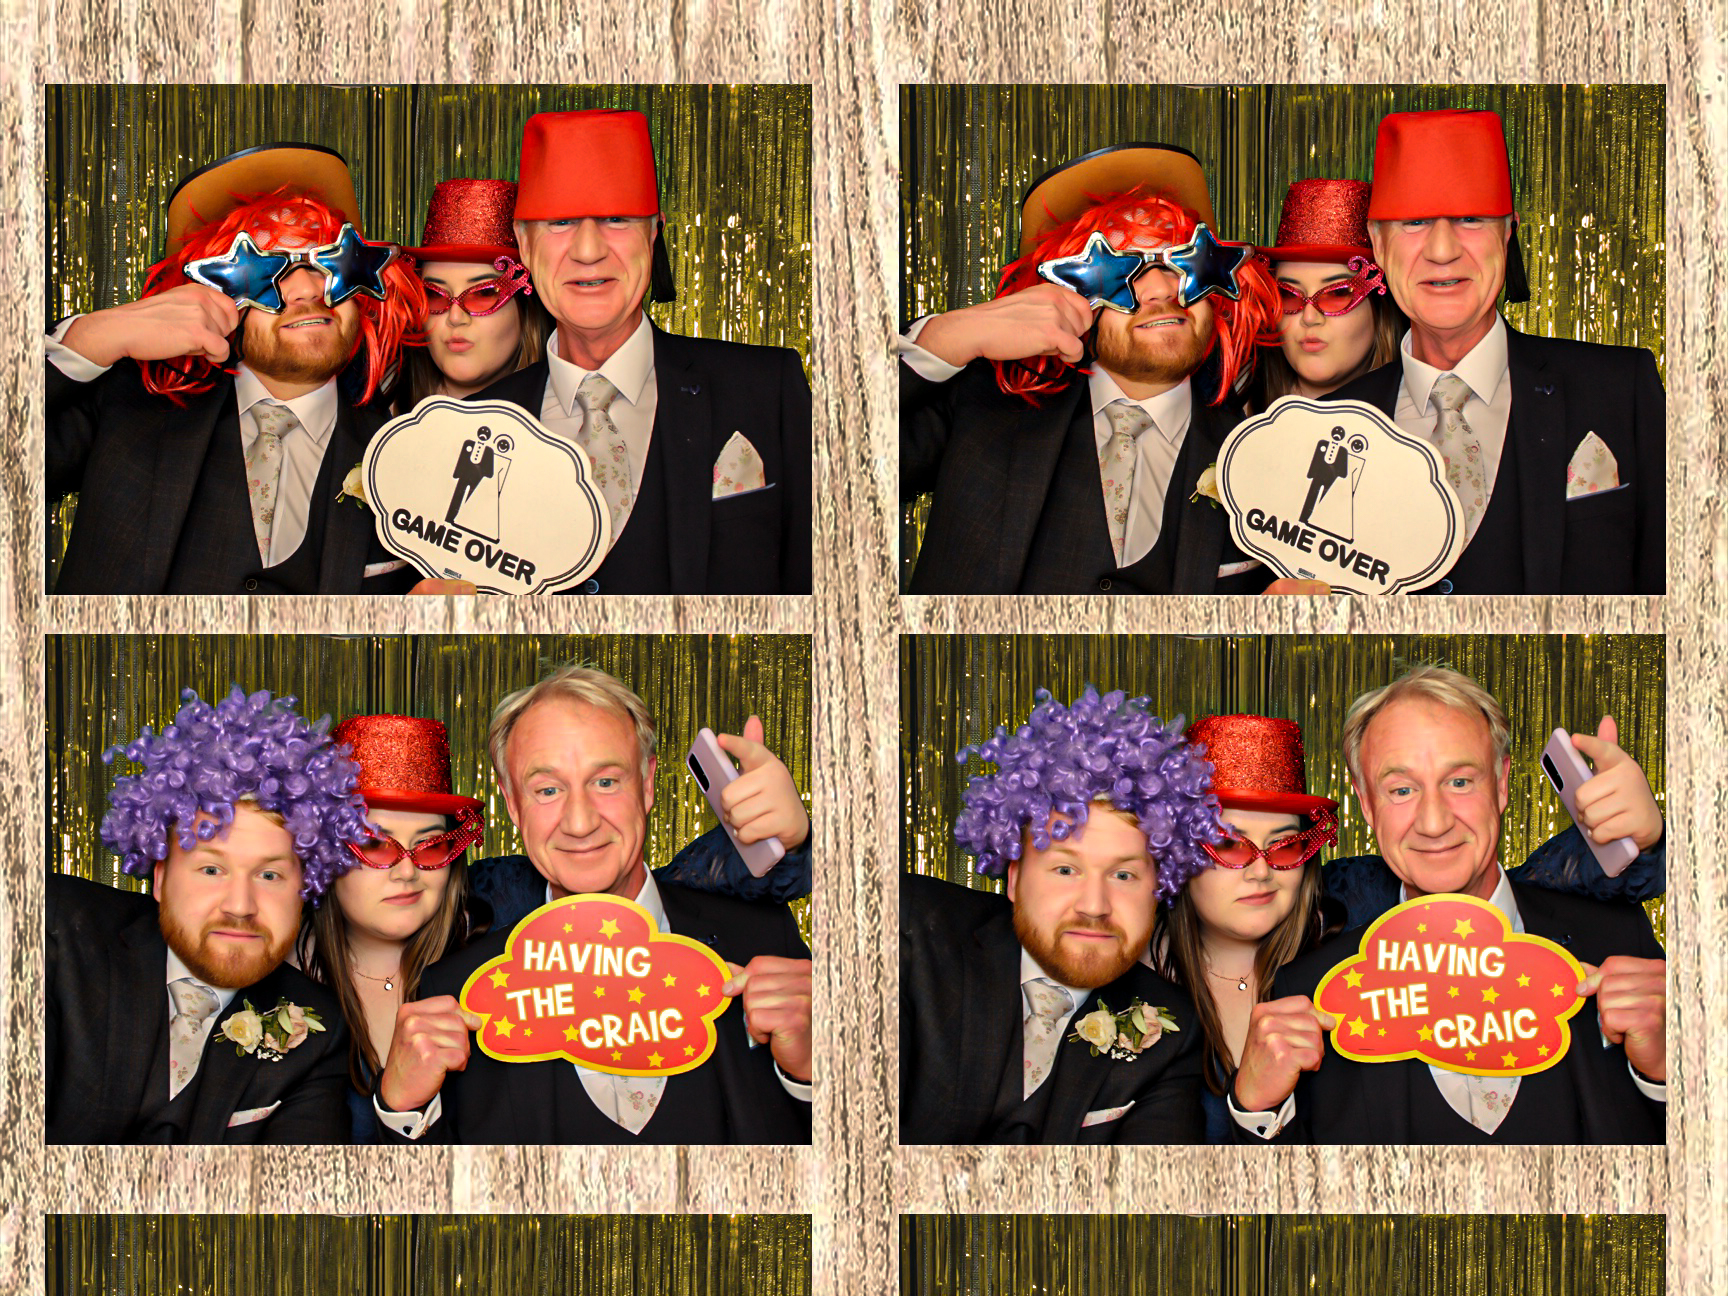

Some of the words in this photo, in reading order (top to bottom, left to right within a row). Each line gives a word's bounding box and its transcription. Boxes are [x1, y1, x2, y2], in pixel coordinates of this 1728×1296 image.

[392, 508, 463, 553] GAME
[464, 539, 536, 585] OVER
[1246, 508, 1317, 553] GAME
[1318, 539, 1390, 585] OVER
[522, 939, 652, 977] HAVING
[1376, 939, 1506, 977] HAVING
[506, 983, 576, 1021] THE
[1360, 983, 1430, 1021] THE
[579, 1008, 685, 1048] CRAIC
[1433, 1008, 1539, 1048] CRAIC
